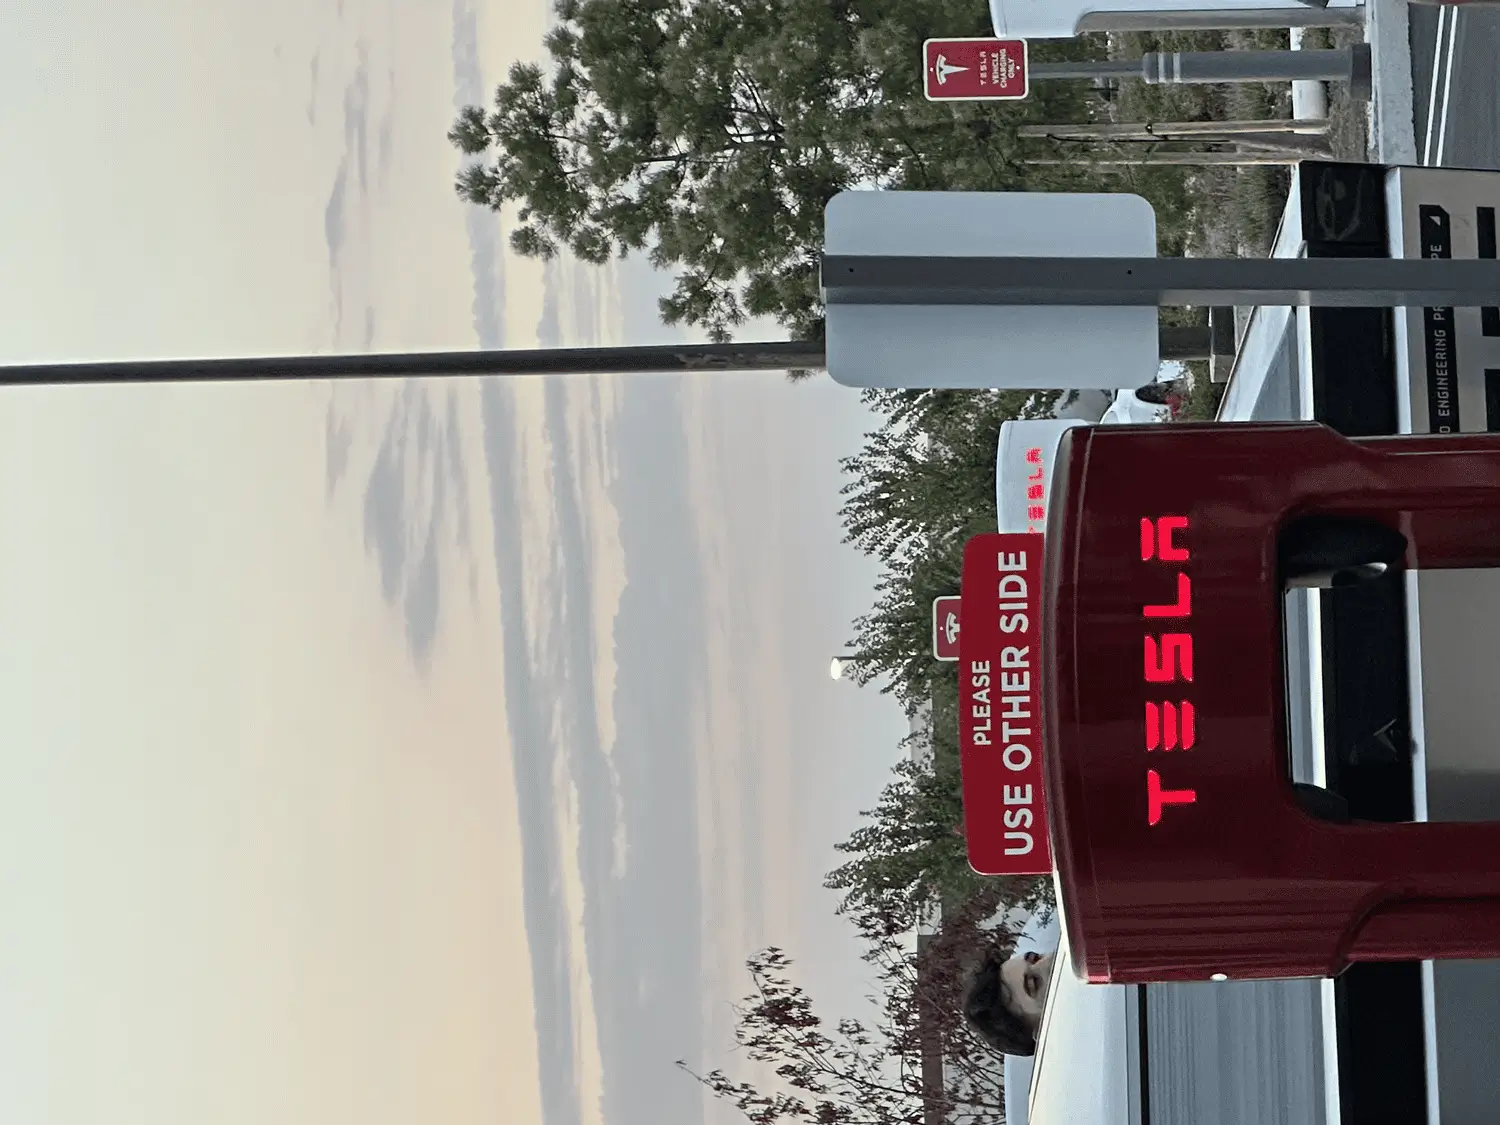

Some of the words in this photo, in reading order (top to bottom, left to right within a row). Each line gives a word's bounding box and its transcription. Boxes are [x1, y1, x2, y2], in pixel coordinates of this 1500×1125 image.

[991, 52, 999, 84] VEHICLE
[999, 48, 1007, 88] CHARGING
[1434, 329, 1450, 417] ENGINEERING
[998, 551, 1029, 634] SIDE
[971, 660, 992, 745] PLEASE
[1000, 645, 1031, 772] OTHER
[1140, 514, 1197, 826] TESLA
[1003, 783, 1034, 856] USE
